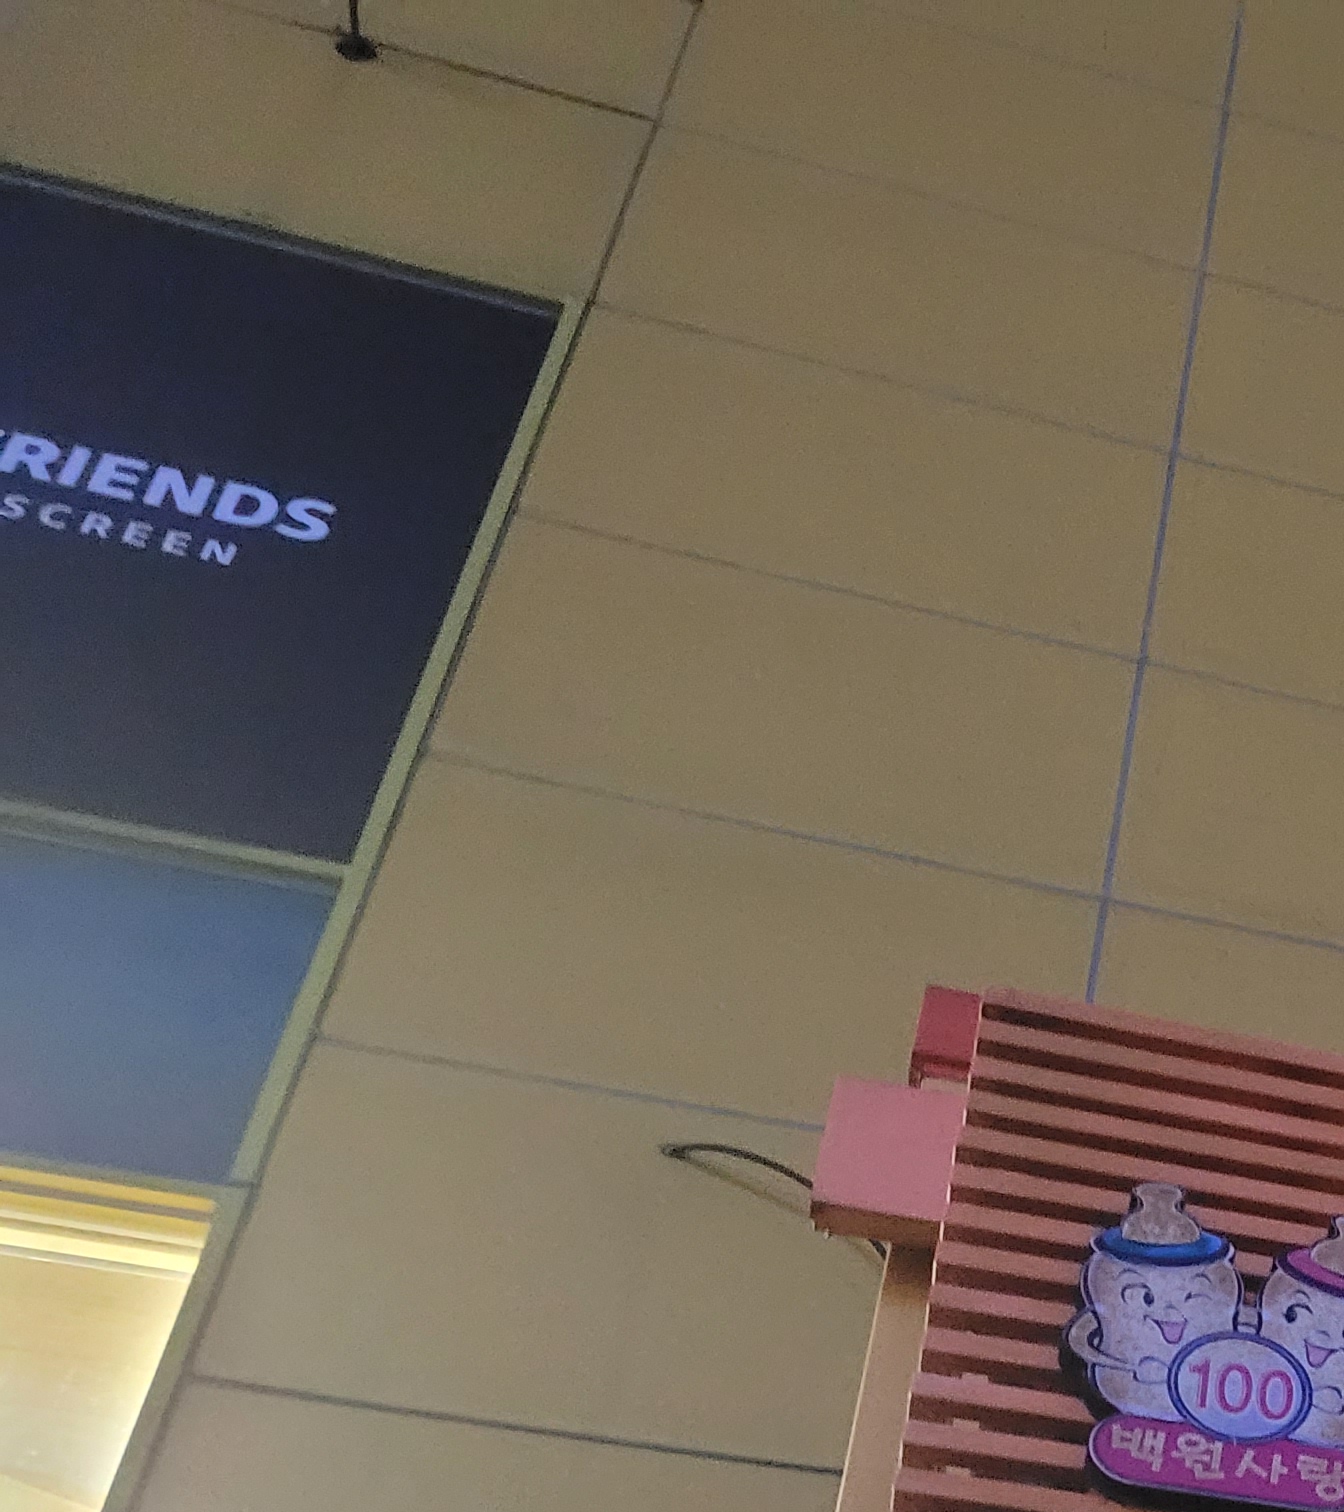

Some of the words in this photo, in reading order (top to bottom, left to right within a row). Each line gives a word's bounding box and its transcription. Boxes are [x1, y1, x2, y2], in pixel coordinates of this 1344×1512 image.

[0, 428, 338, 543] RIENDS
[0, 492, 240, 567] SCREEN
[1188, 1357, 1295, 1421] 100
